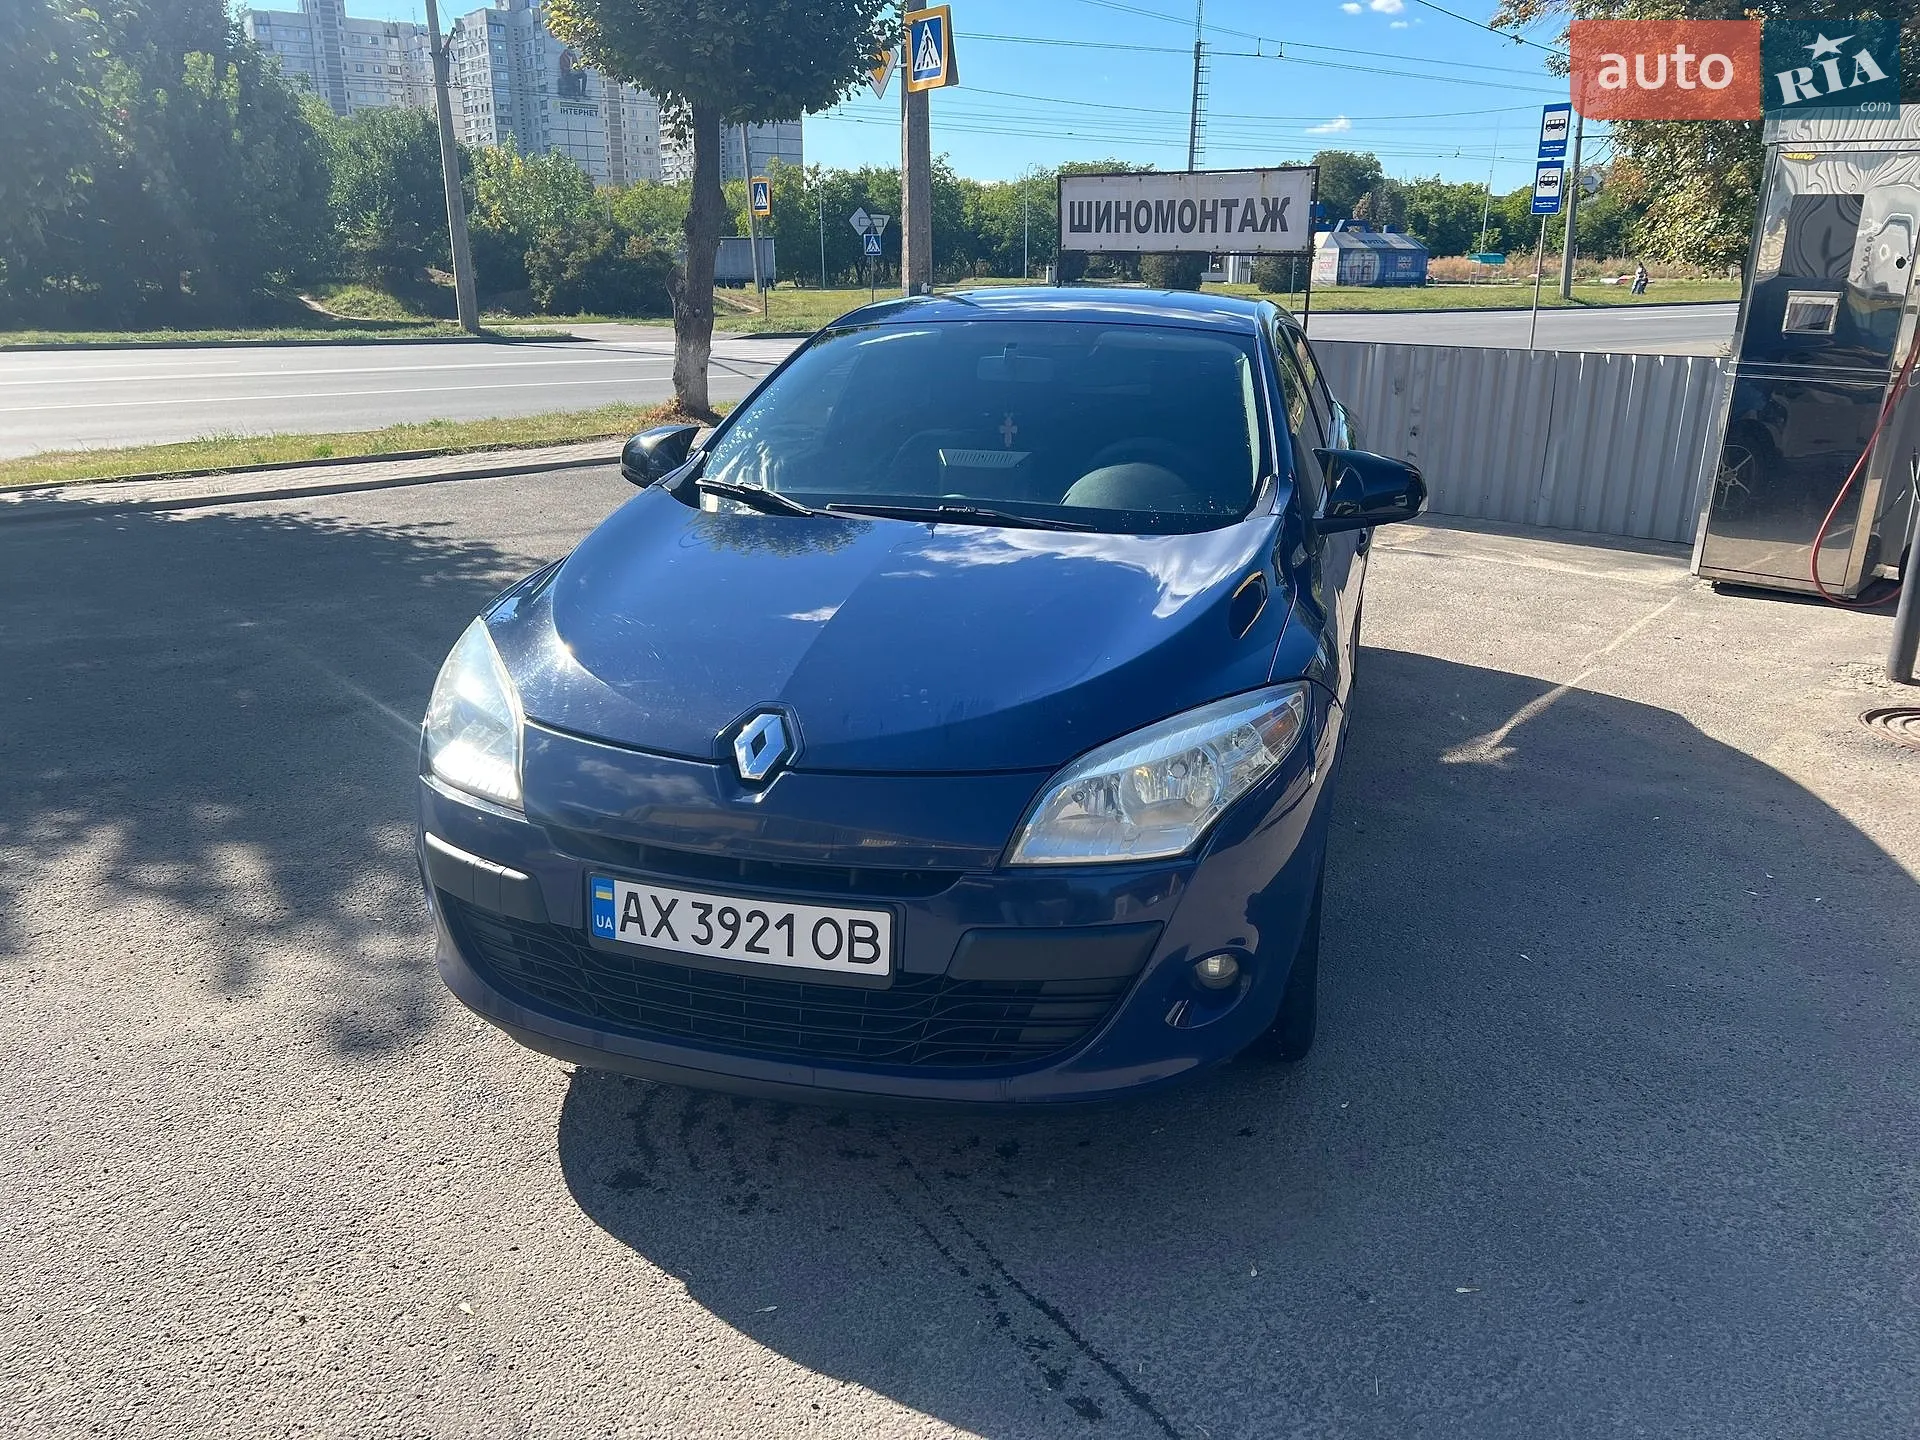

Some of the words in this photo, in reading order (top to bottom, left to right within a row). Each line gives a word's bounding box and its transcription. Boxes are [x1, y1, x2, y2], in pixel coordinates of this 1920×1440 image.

[1068, 196, 1290, 234] ШИНОМОНТАЖ
[596, 915, 613, 930] UA
[619, 891, 680, 942] AX
[690, 901, 795, 957] 3921
[811, 916, 881, 964] OB
